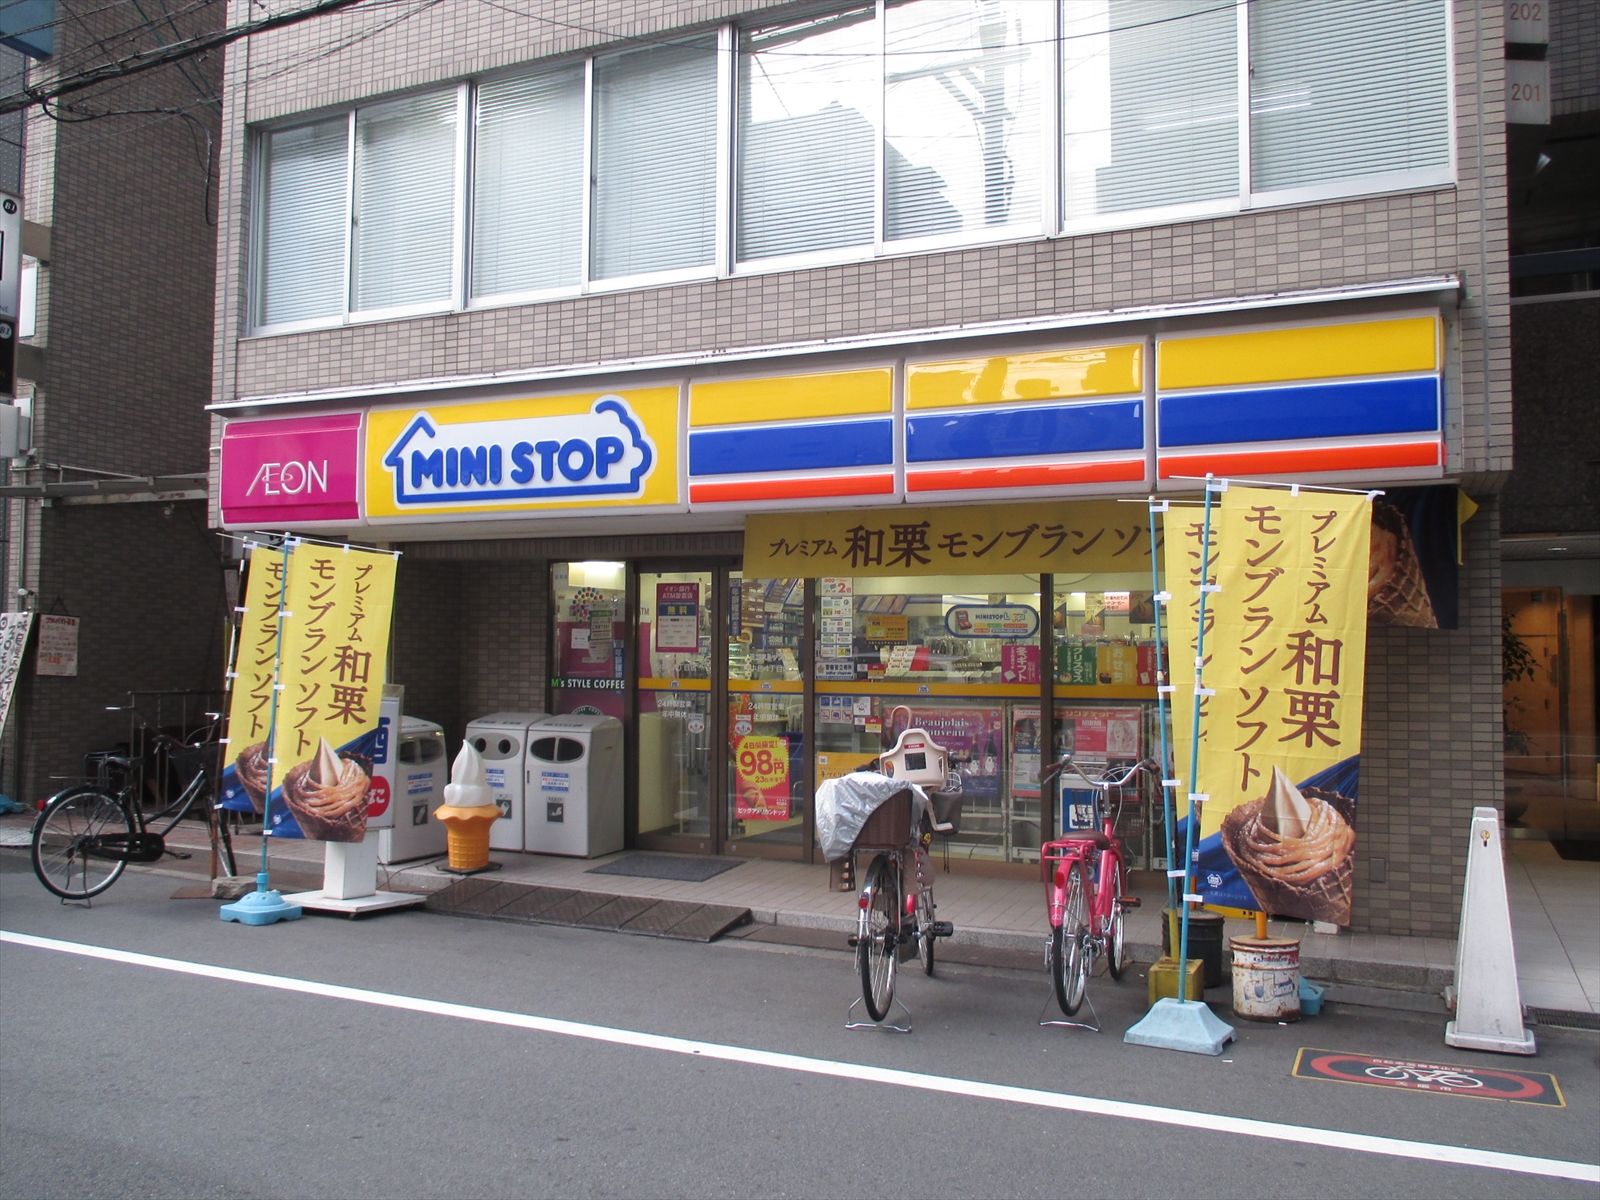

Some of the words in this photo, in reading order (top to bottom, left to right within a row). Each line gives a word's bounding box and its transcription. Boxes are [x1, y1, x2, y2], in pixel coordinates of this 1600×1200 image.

[1510, 3, 1542, 20] 202
[1511, 83, 1540, 101] 201
[411, 444, 501, 489] MINI
[511, 436, 625, 484] STOP
[293, 558, 336, 756] モンブランソフト
[1234, 505, 1284, 792] モンブランソフト
[567, 679, 591, 689] STYLE
[594, 679, 625, 690] COFFEE
[915, 717, 969, 729] Beaujolais
[922, 729, 965, 737] ouveau
